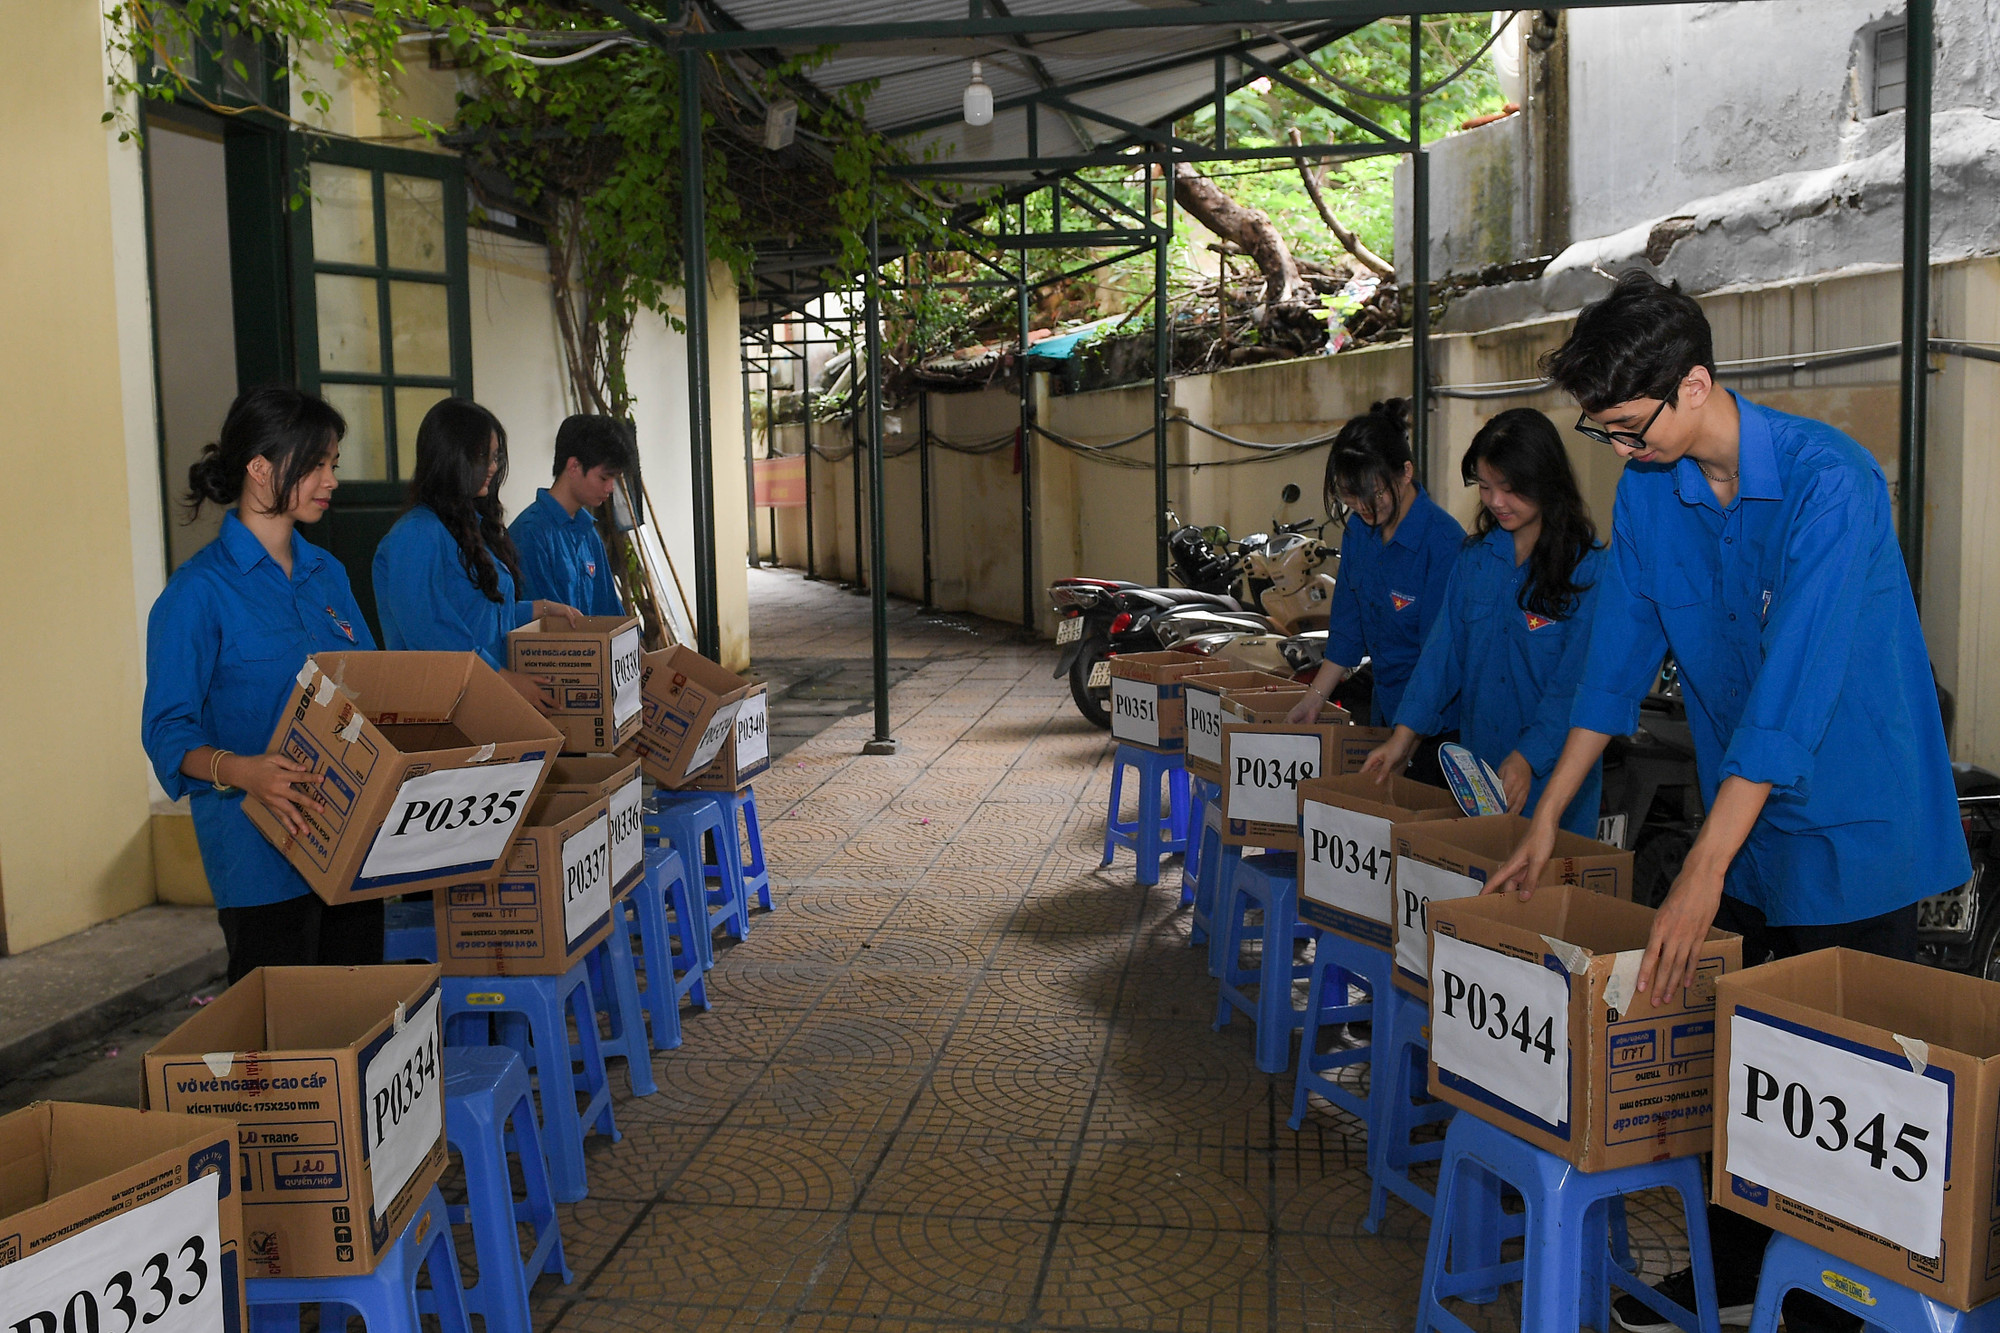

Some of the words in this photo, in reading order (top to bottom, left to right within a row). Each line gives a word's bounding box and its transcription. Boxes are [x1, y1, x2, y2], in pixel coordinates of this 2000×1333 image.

[614, 650, 638, 687] P0338
[738, 712, 765, 744] P0340
[1116, 694, 1155, 722] P0351
[1191, 707, 1220, 737] P035
[1235, 756, 1314, 790] P0348
[390, 790, 525, 836] P0335
[567, 843, 606, 904] P0337
[1310, 828, 1392, 885] P0347
[1441, 969, 1555, 1065] P0344
[373, 1031, 434, 1149] P0334
[1741, 1063, 1930, 1183] P0345
